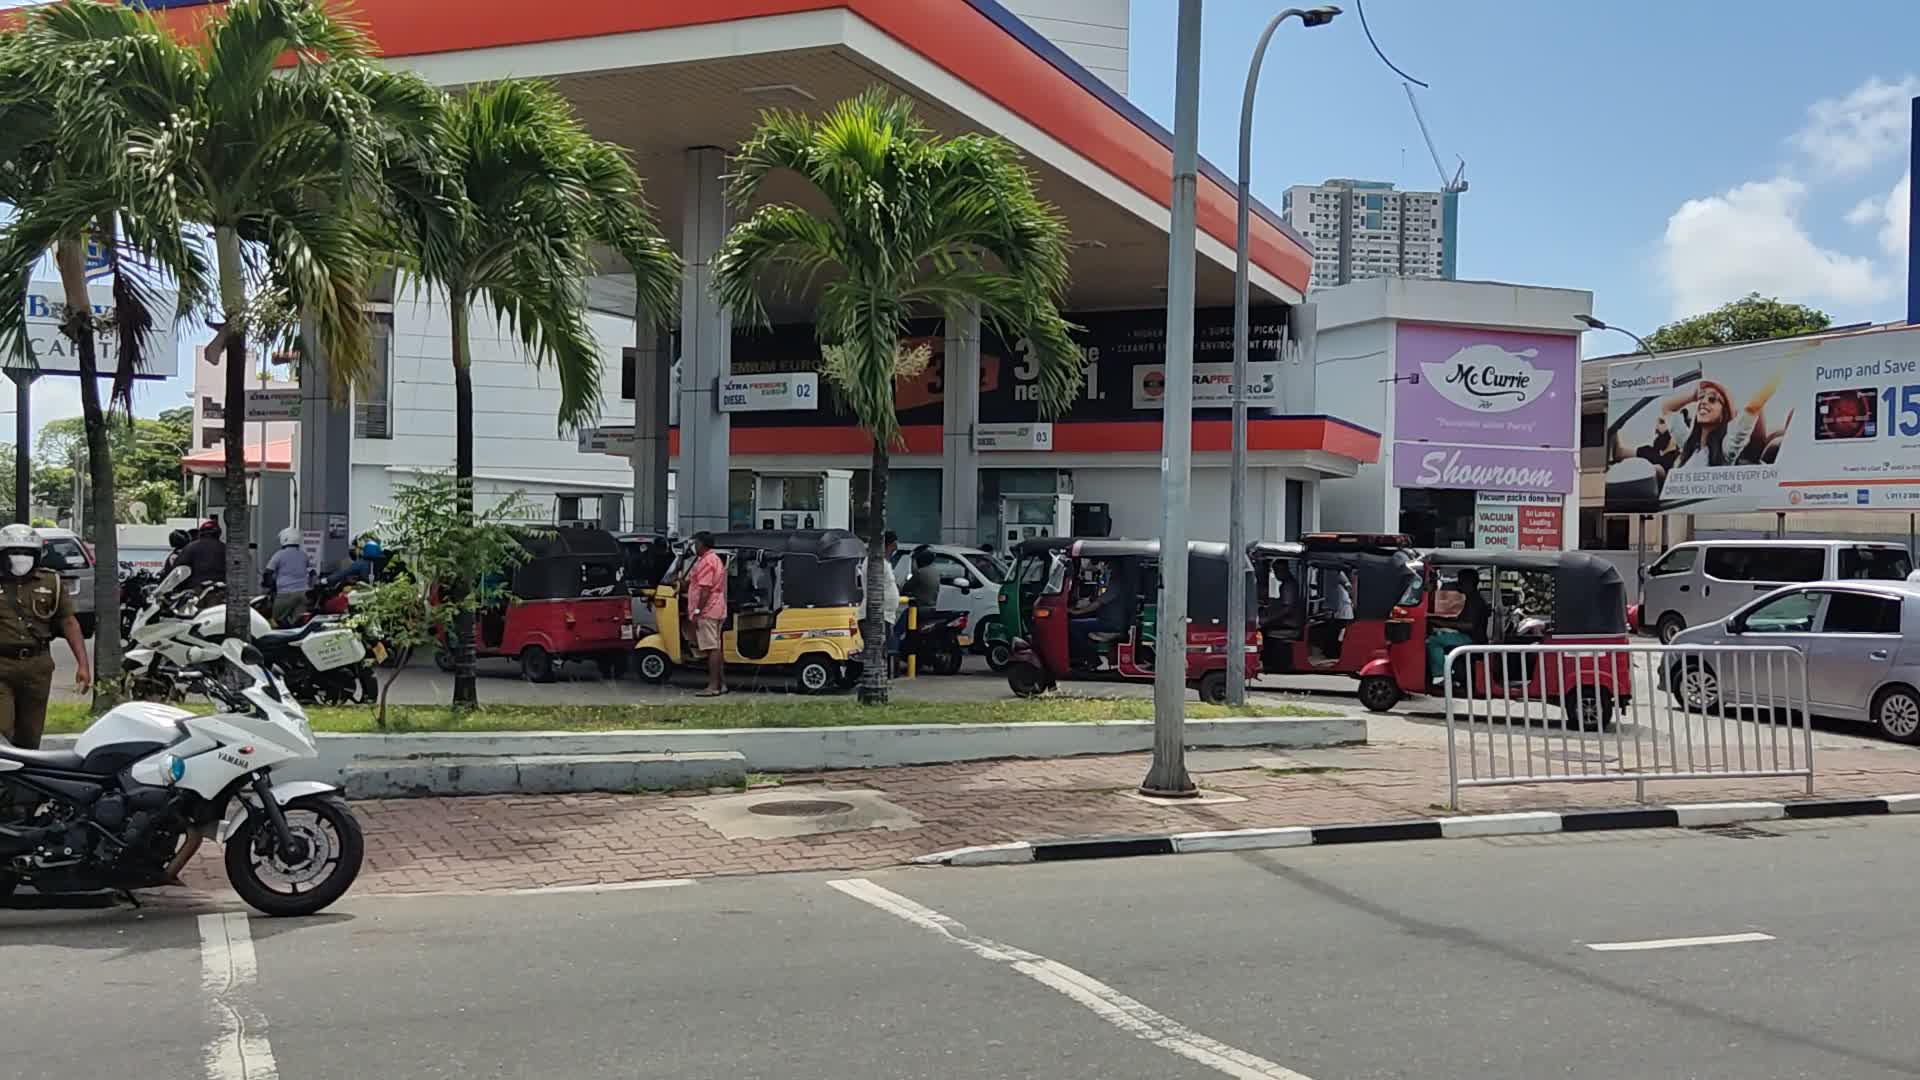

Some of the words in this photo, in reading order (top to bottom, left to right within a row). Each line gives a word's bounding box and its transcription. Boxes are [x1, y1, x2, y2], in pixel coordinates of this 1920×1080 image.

[1200, 339, 1260, 351] ENVIRONT
[1816, 366, 1853, 381] Pump
[1855, 361, 1881, 377] and
[1883, 359, 1916, 375] Save
[795, 383, 811, 398] 02
[1227, 383, 1262, 394] ERO
[723, 394, 747, 406] DIESEL
[1036, 431, 1048, 443] 03
[1417, 450, 1553, 488] Showroom
[1711, 471, 1736, 481] WHEN
[1761, 470, 1778, 479] DAY
[1479, 512, 1514, 522] VACUUM
[1478, 525, 1515, 534] PACKING
[1485, 536, 1508, 545] DONE
[217, 751, 249, 770] YAMAHA
